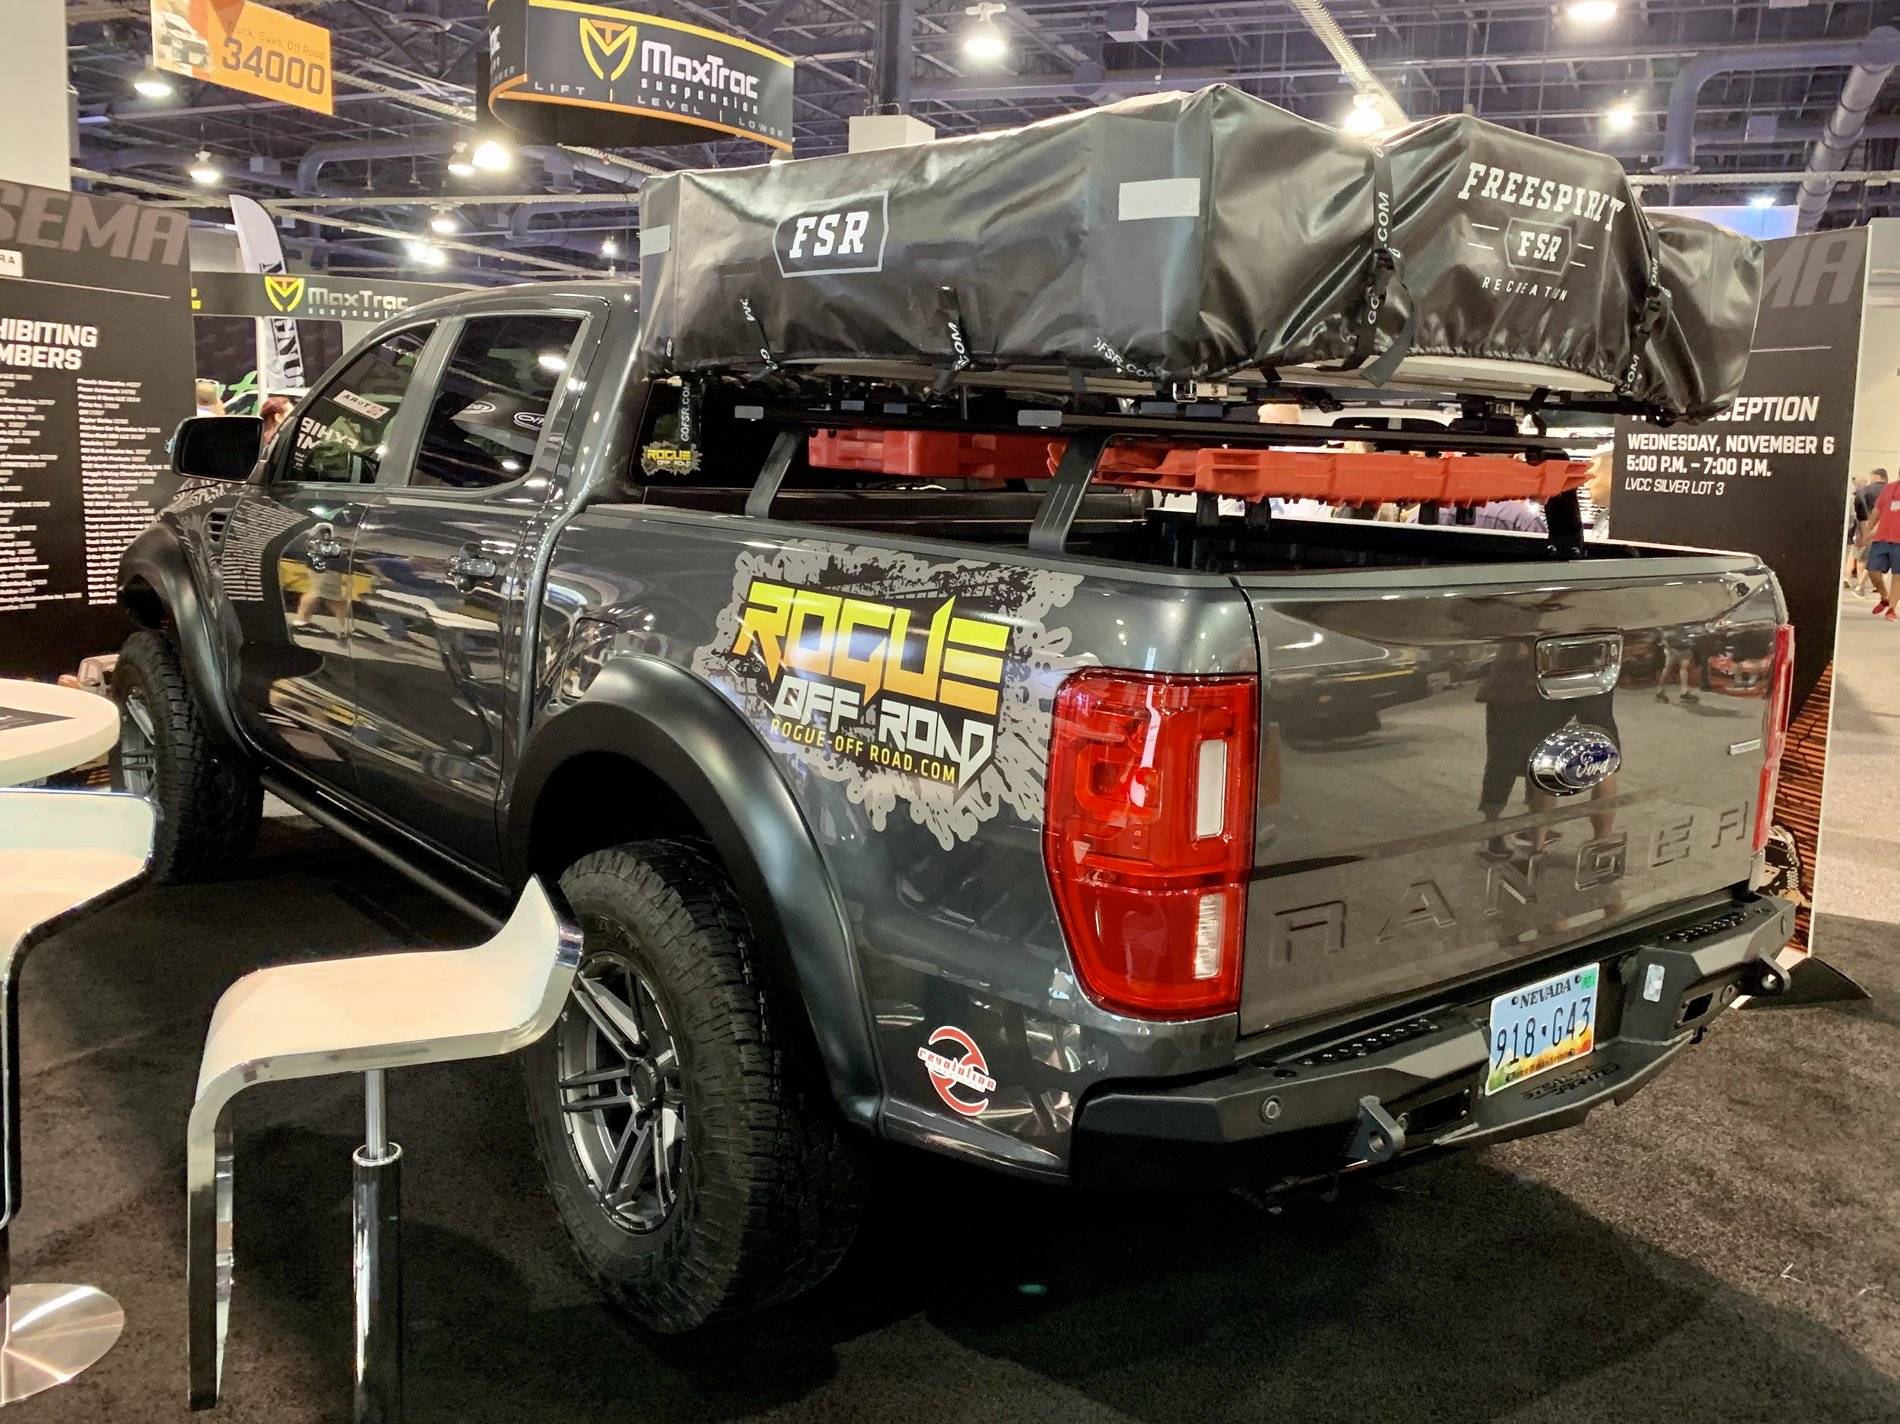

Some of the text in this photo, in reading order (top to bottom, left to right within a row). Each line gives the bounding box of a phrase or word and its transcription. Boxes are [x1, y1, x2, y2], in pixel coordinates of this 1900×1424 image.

[222, 37, 326, 96] 34000
[641, 40, 759, 99] MaxTrac
[535, 81, 784, 137] LIFT LEVEL LOWER
[1457, 162, 1626, 232] FREESPIRIT
[788, 211, 869, 259] FSR
[1517, 231, 1562, 262] FSR
[307, 287, 409, 310] MaxTrac
[1708, 396, 1820, 422] CEPTION
[647, 449, 691, 461] ROGUE
[1627, 433, 1835, 455] WEDNESDAY, NOVEMBER 6
[1626, 454, 1657, 472] 5:00
[1660, 455, 1688, 473] P.M.
[1703, 457, 1737, 475] 7:00
[1741, 459, 1773, 477] P.M.
[1624, 478, 1725, 496] LVCC SILVER LOT 3
[732, 581, 1010, 716] ROGUE
[774, 676, 861, 733] OFF
[869, 748, 956, 784] ROAD.COM
[1575, 750, 1610, 779] Ford
[1519, 978, 1571, 1009] NEVADA
